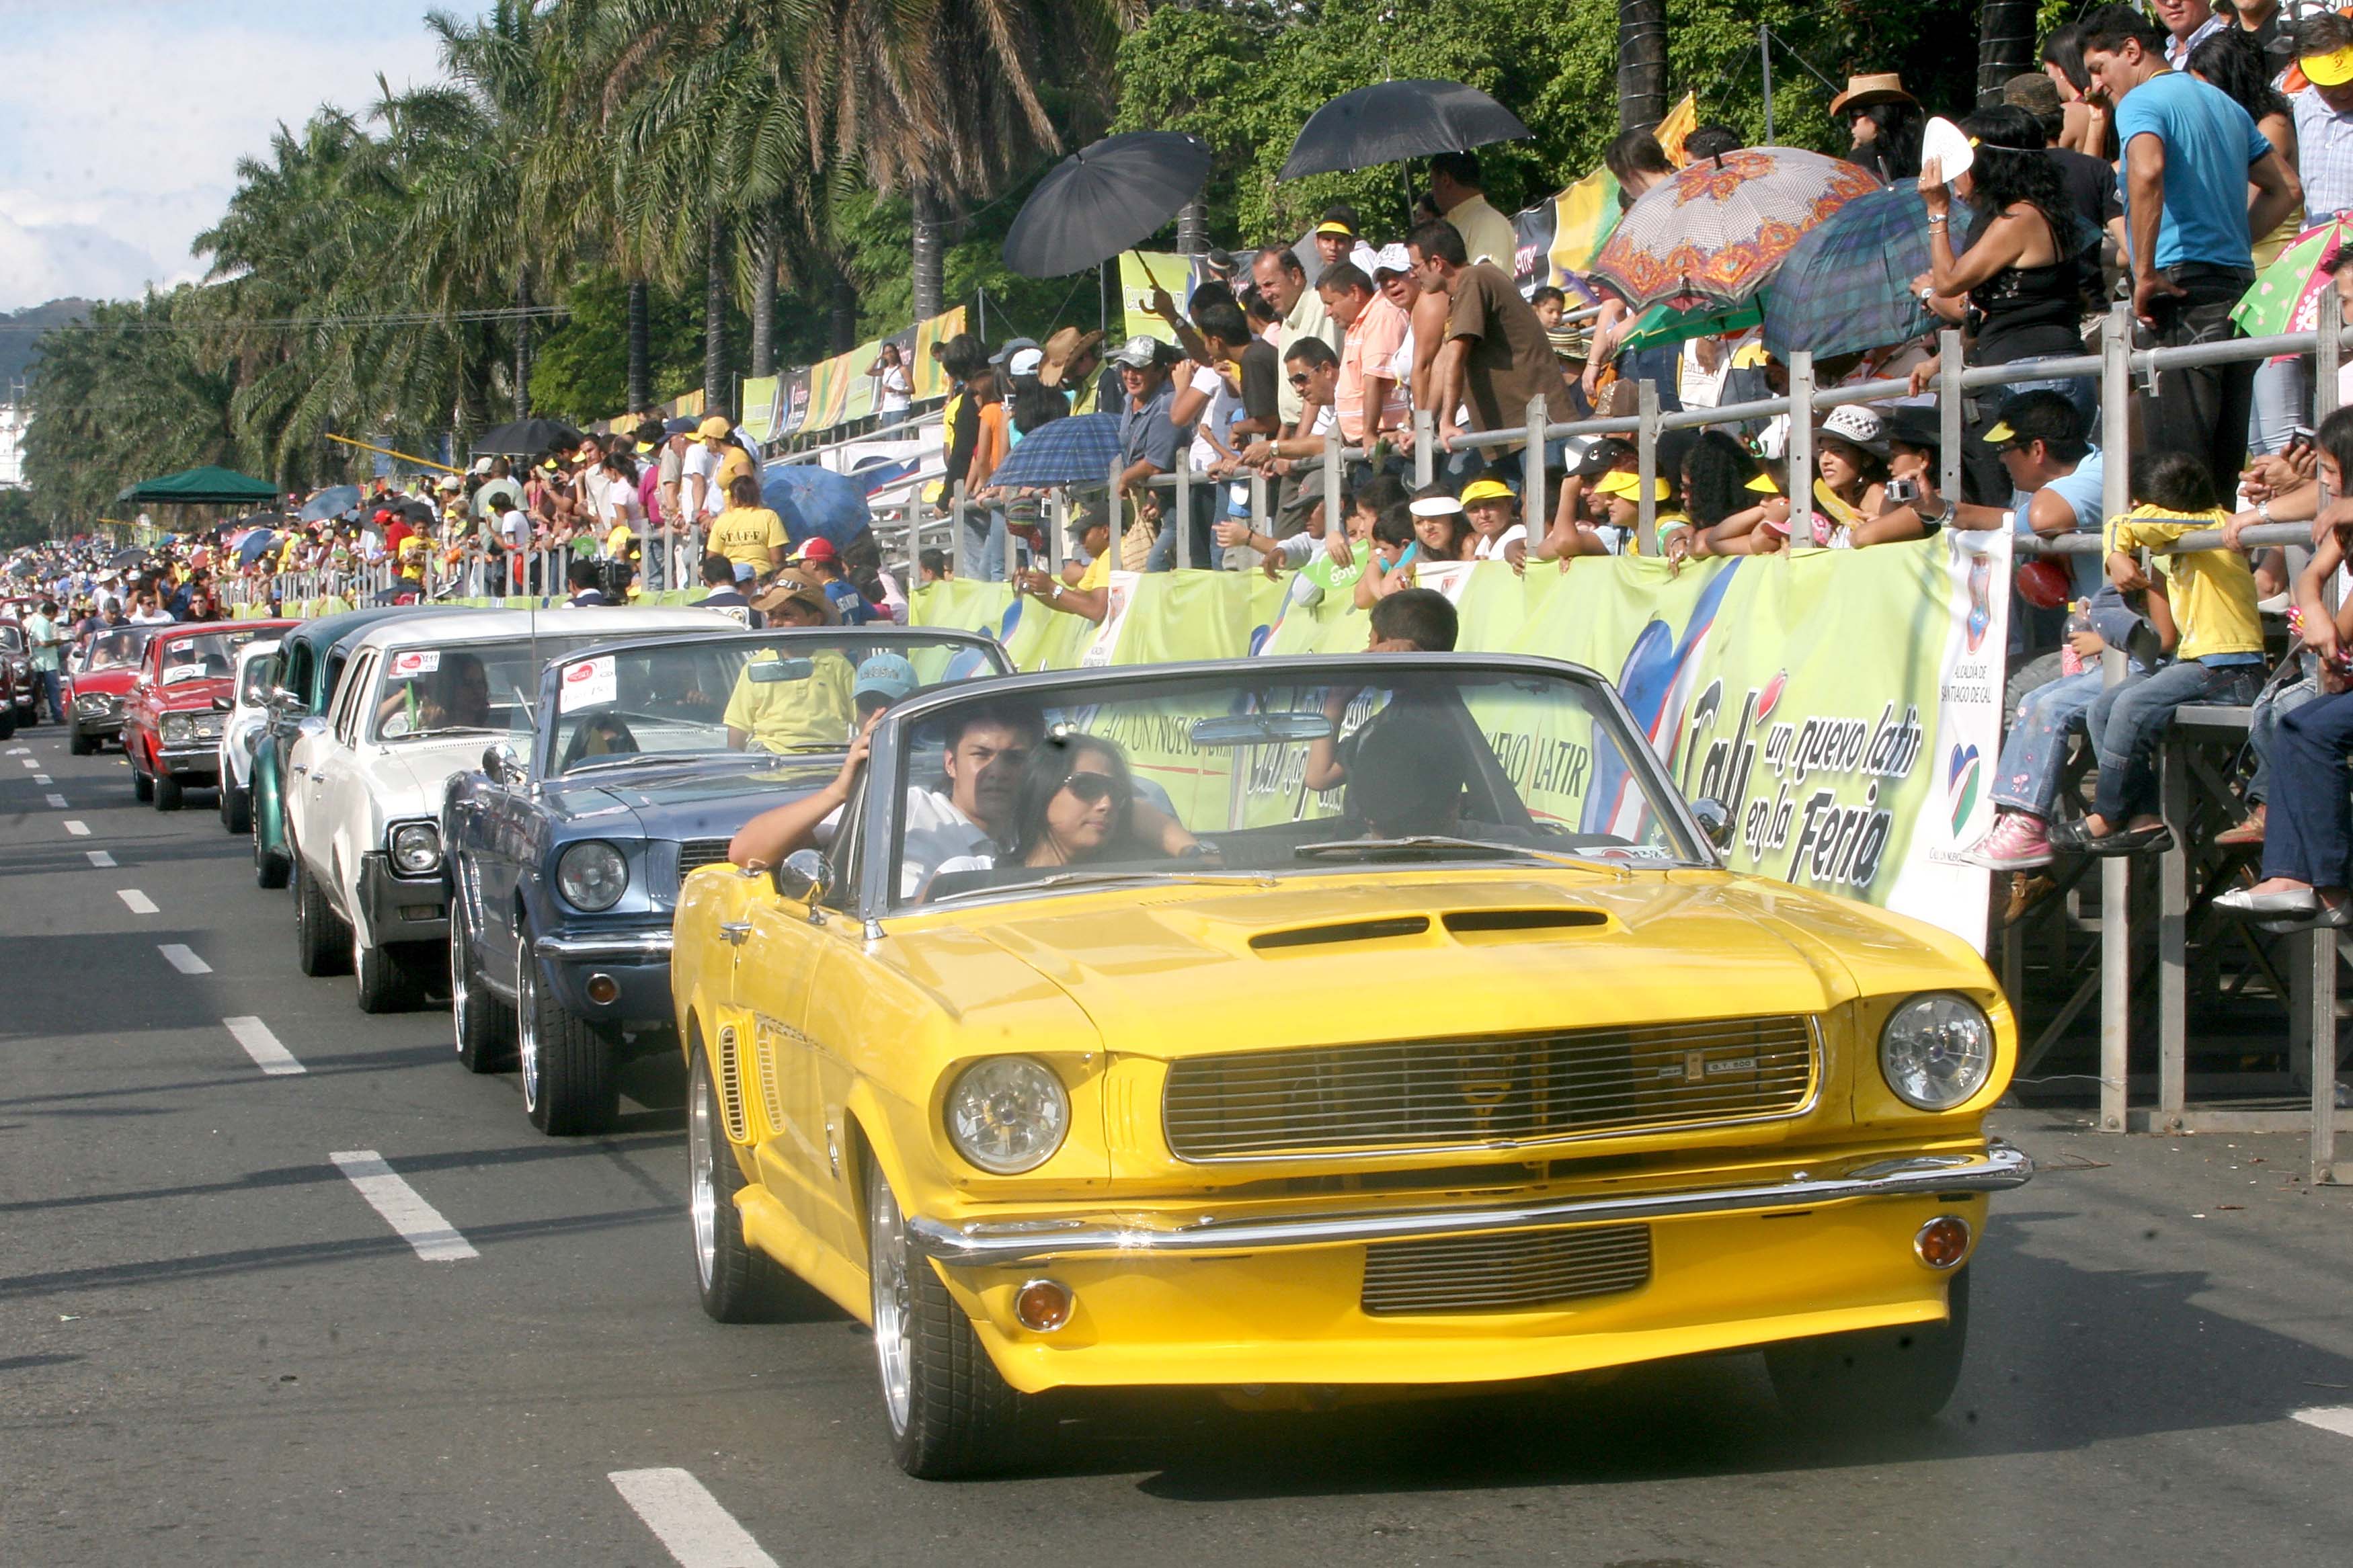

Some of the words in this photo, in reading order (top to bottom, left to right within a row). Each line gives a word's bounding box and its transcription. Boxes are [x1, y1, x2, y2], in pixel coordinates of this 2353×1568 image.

[1330, 564, 1356, 586] tigo
[1979, 665, 1987, 679] DE
[1970, 686, 1980, 703] DE
[1764, 722, 1795, 778] un
[1790, 716, 1868, 785] nuevo
[1860, 699, 1923, 778] latir
[1532, 737, 1588, 798] LATIR
[1745, 796, 1770, 863] en
[1764, 778, 1796, 850] la
[1787, 778, 1892, 887] Feria
